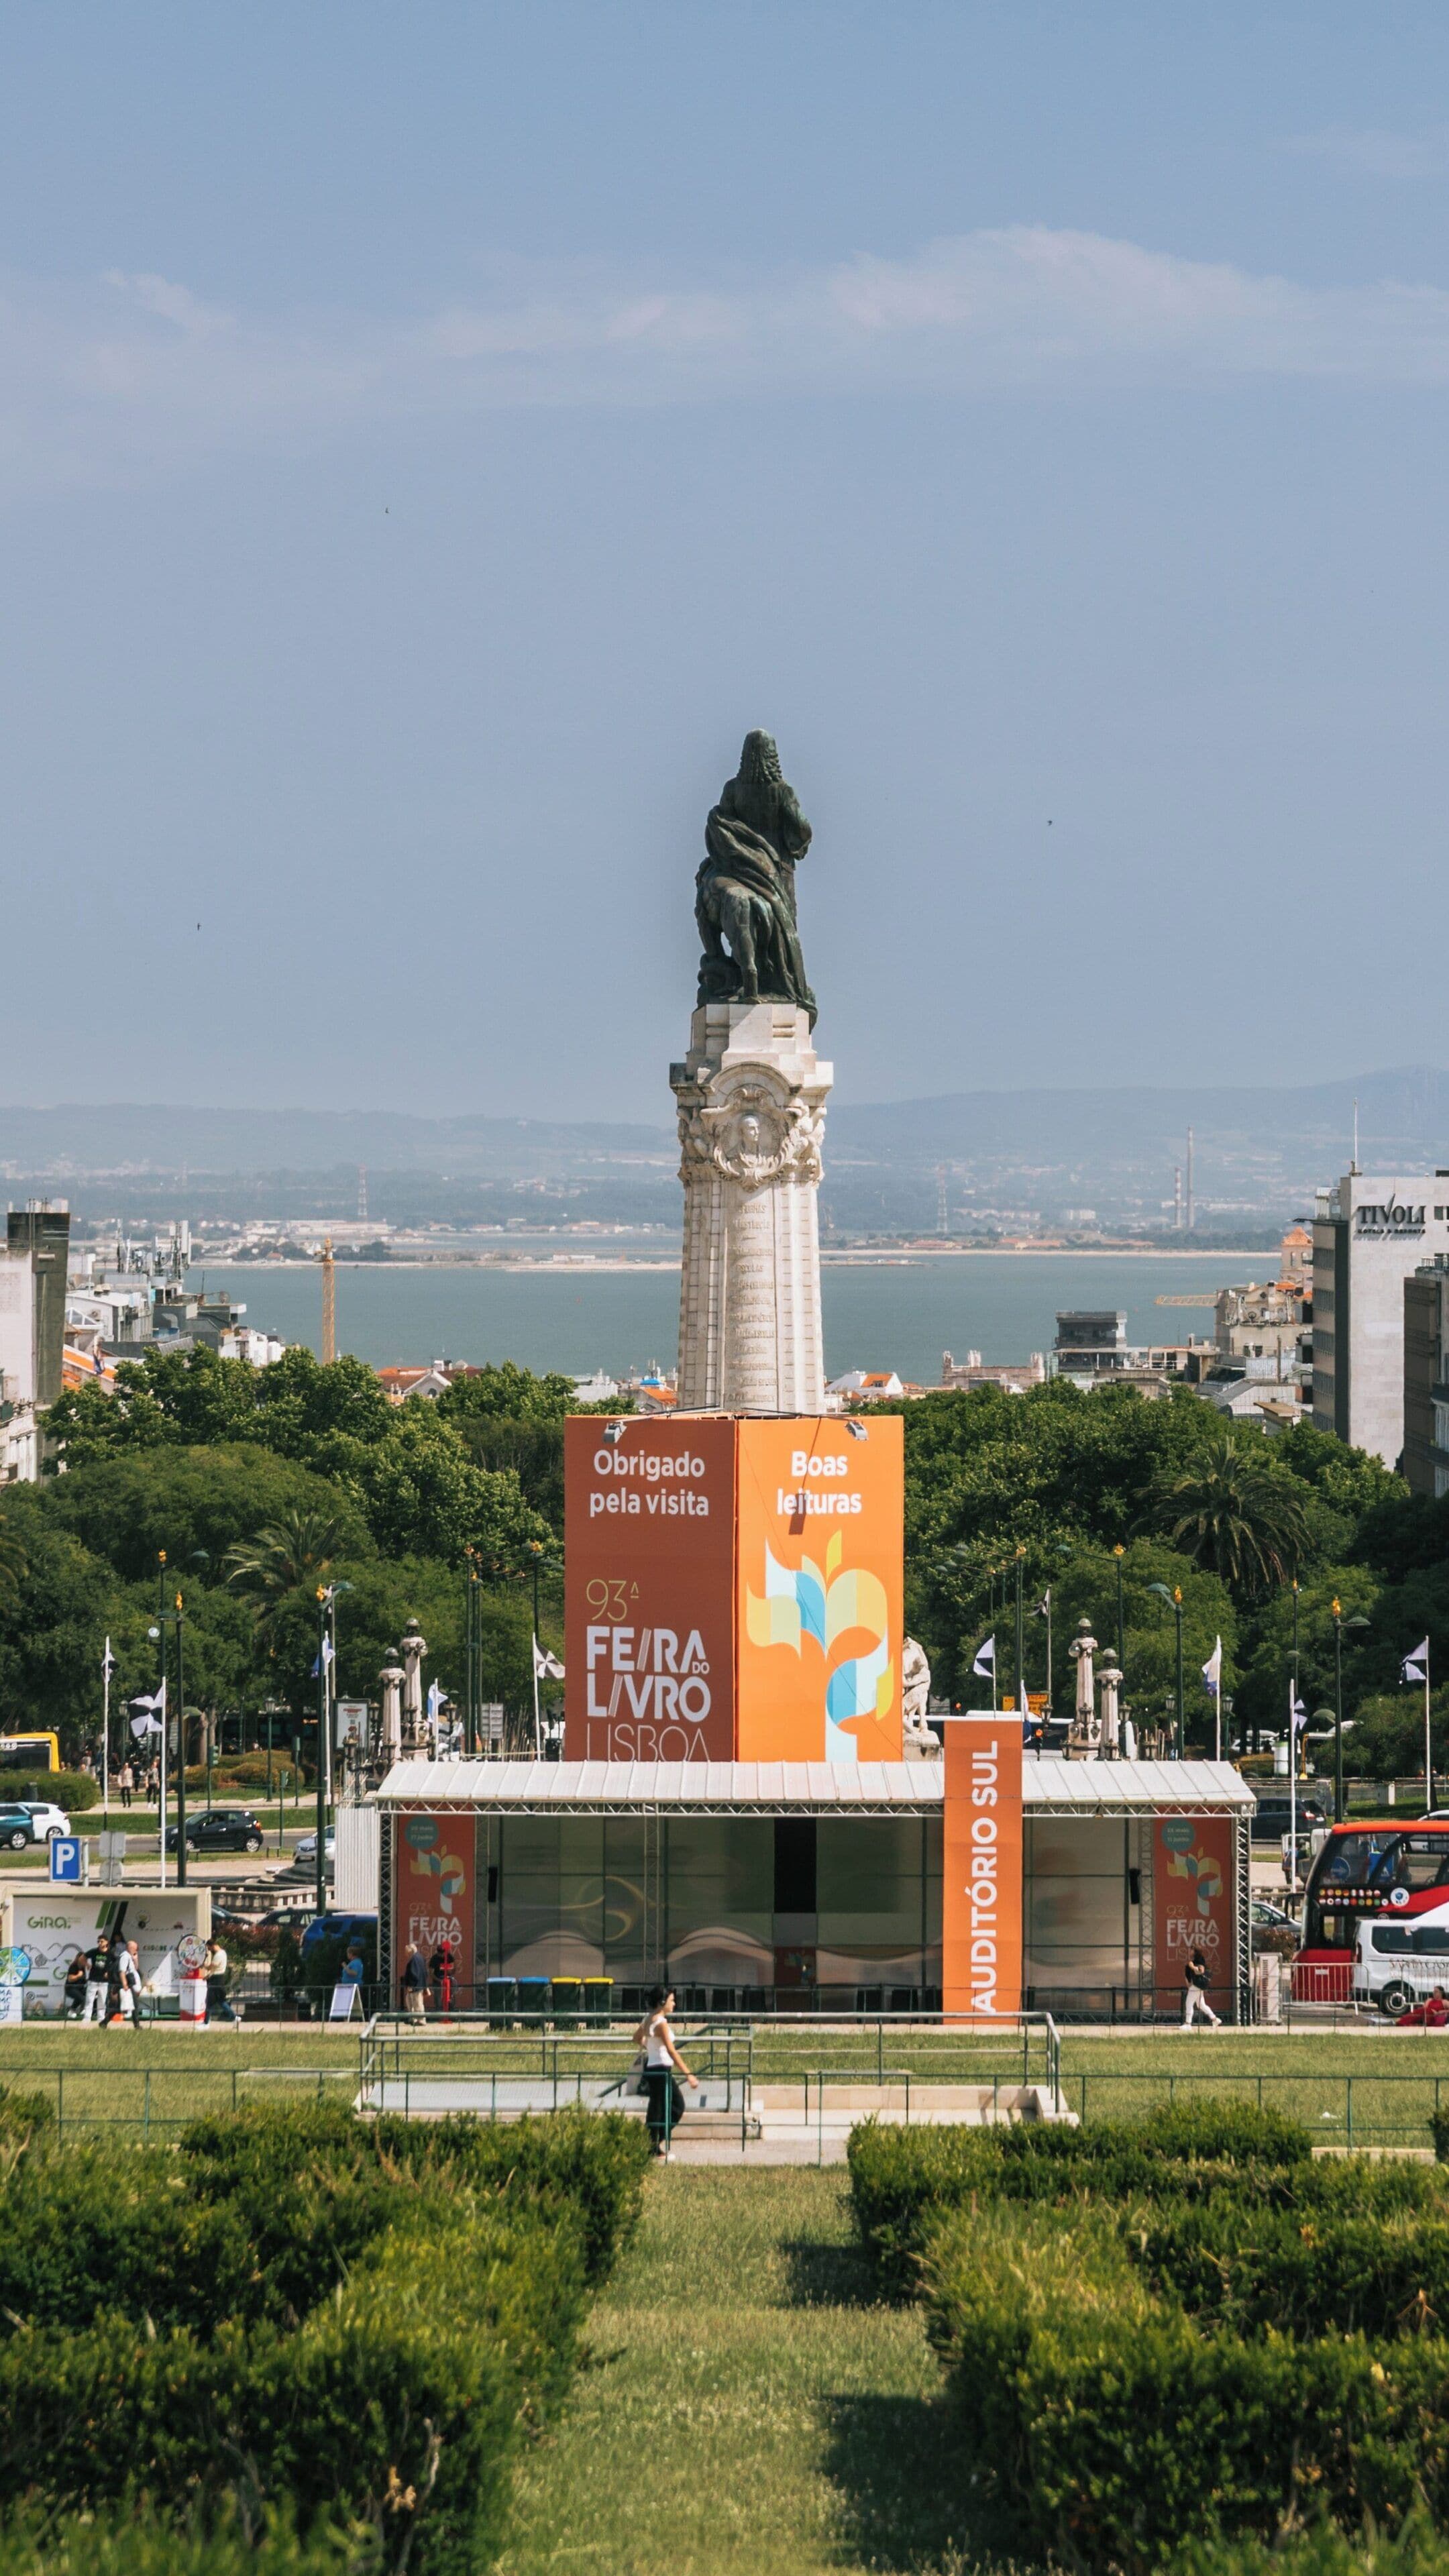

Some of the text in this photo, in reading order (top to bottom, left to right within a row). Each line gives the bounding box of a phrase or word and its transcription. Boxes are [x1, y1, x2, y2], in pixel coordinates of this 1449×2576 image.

[1357, 1193, 1426, 1224] TIVOLI
[594, 1449, 705, 1481] Obrigado
[792, 1450, 848, 1477] Boas
[590, 1487, 709, 1517] pela visita
[777, 1487, 862, 1515] leituras
[587, 1625, 710, 1674] FEIRA DO
[587, 1672, 711, 1723] LIVRO
[587, 1723, 710, 1762] LISBOA
[56, 1843, 75, 1875] P
[965, 1740, 998, 2014] AUDITÓRIO SUL
[409, 1917, 461, 1931] FEIRA
[1167, 1919, 1218, 1933] FEIRA
[1167, 1933, 1220, 1947] LIVRO
